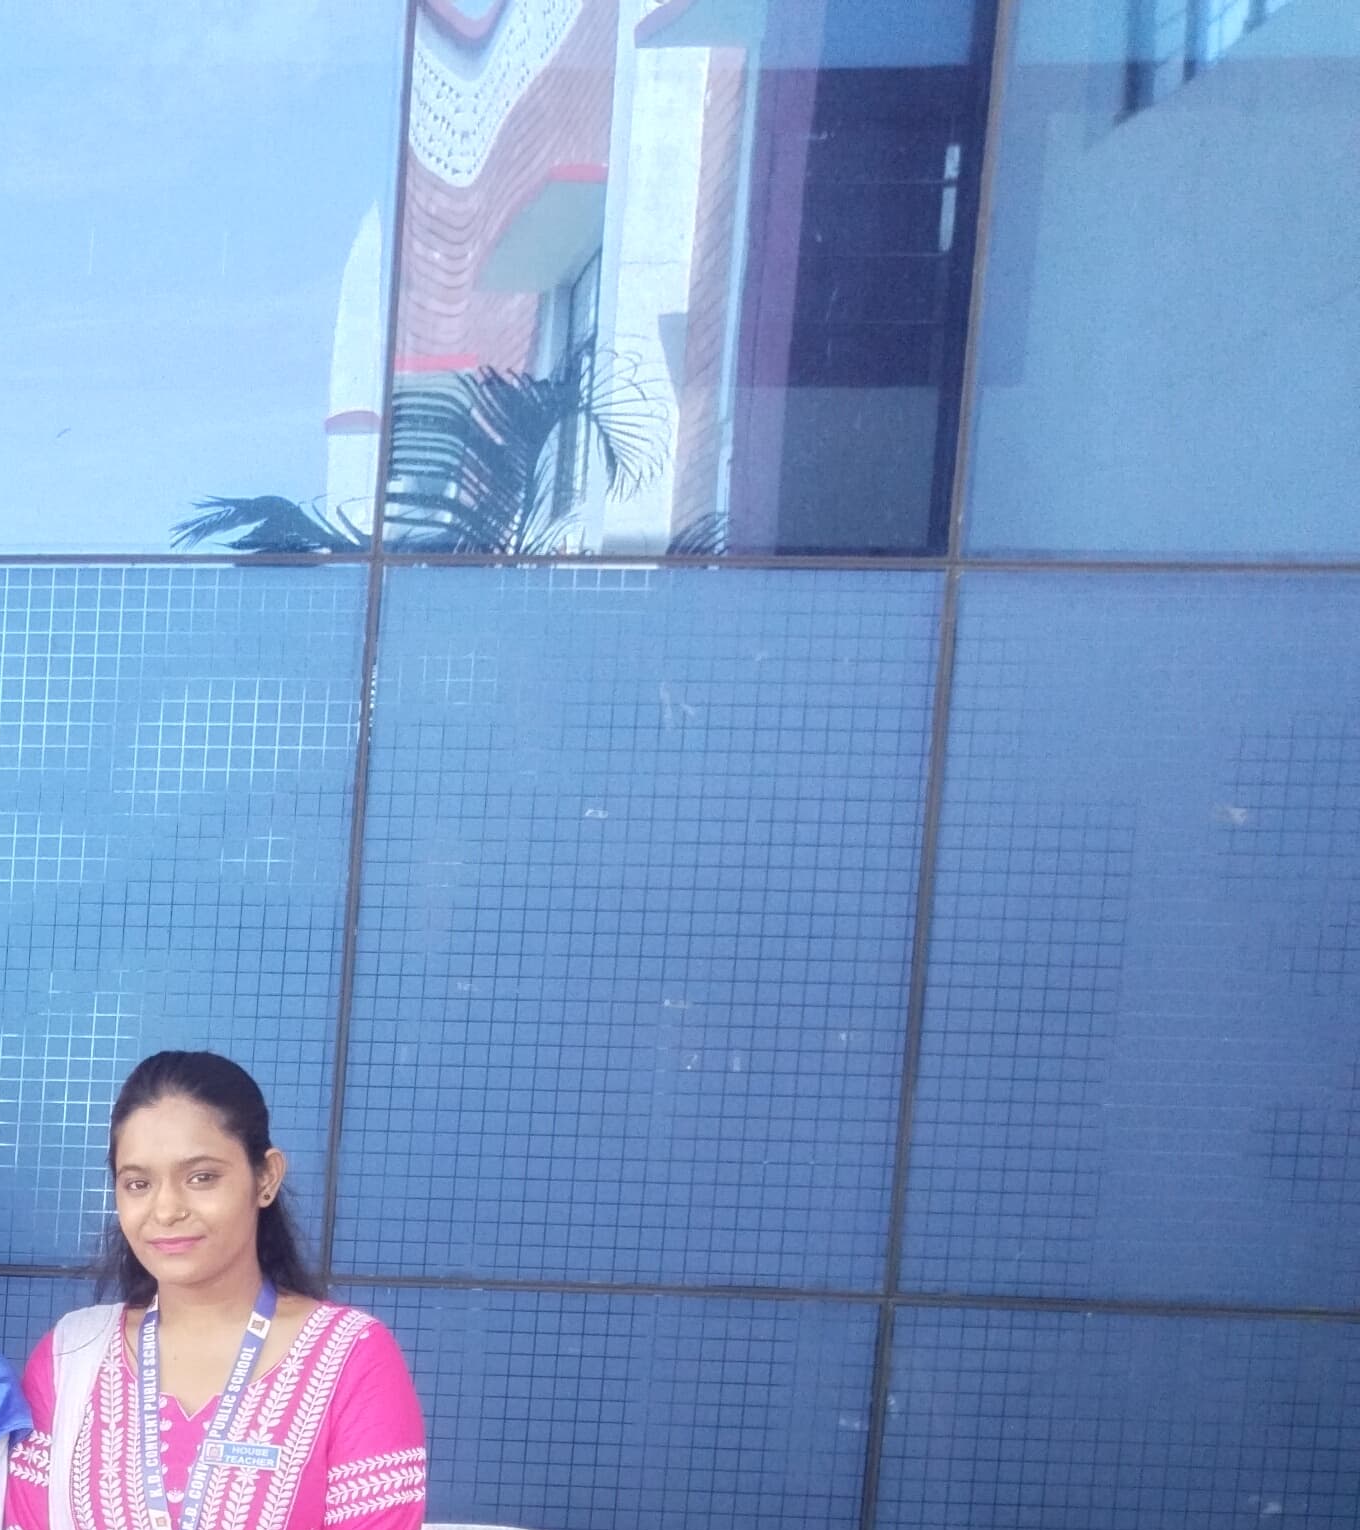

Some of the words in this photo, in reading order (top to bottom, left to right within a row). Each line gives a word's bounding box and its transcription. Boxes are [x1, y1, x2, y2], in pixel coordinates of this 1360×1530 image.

[143, 1319, 156, 1366] SCHOOL
[143, 1368, 158, 1412] PUBLIC
[208, 1391, 236, 1438] PUBLIC
[228, 1346, 257, 1392] SCHOOL
[144, 1413, 159, 1468] CONVENT
[224, 1455, 274, 1467] TEACHER
[231, 1445, 269, 1457] HOUSE
[148, 1470, 163, 1499] K.D.
